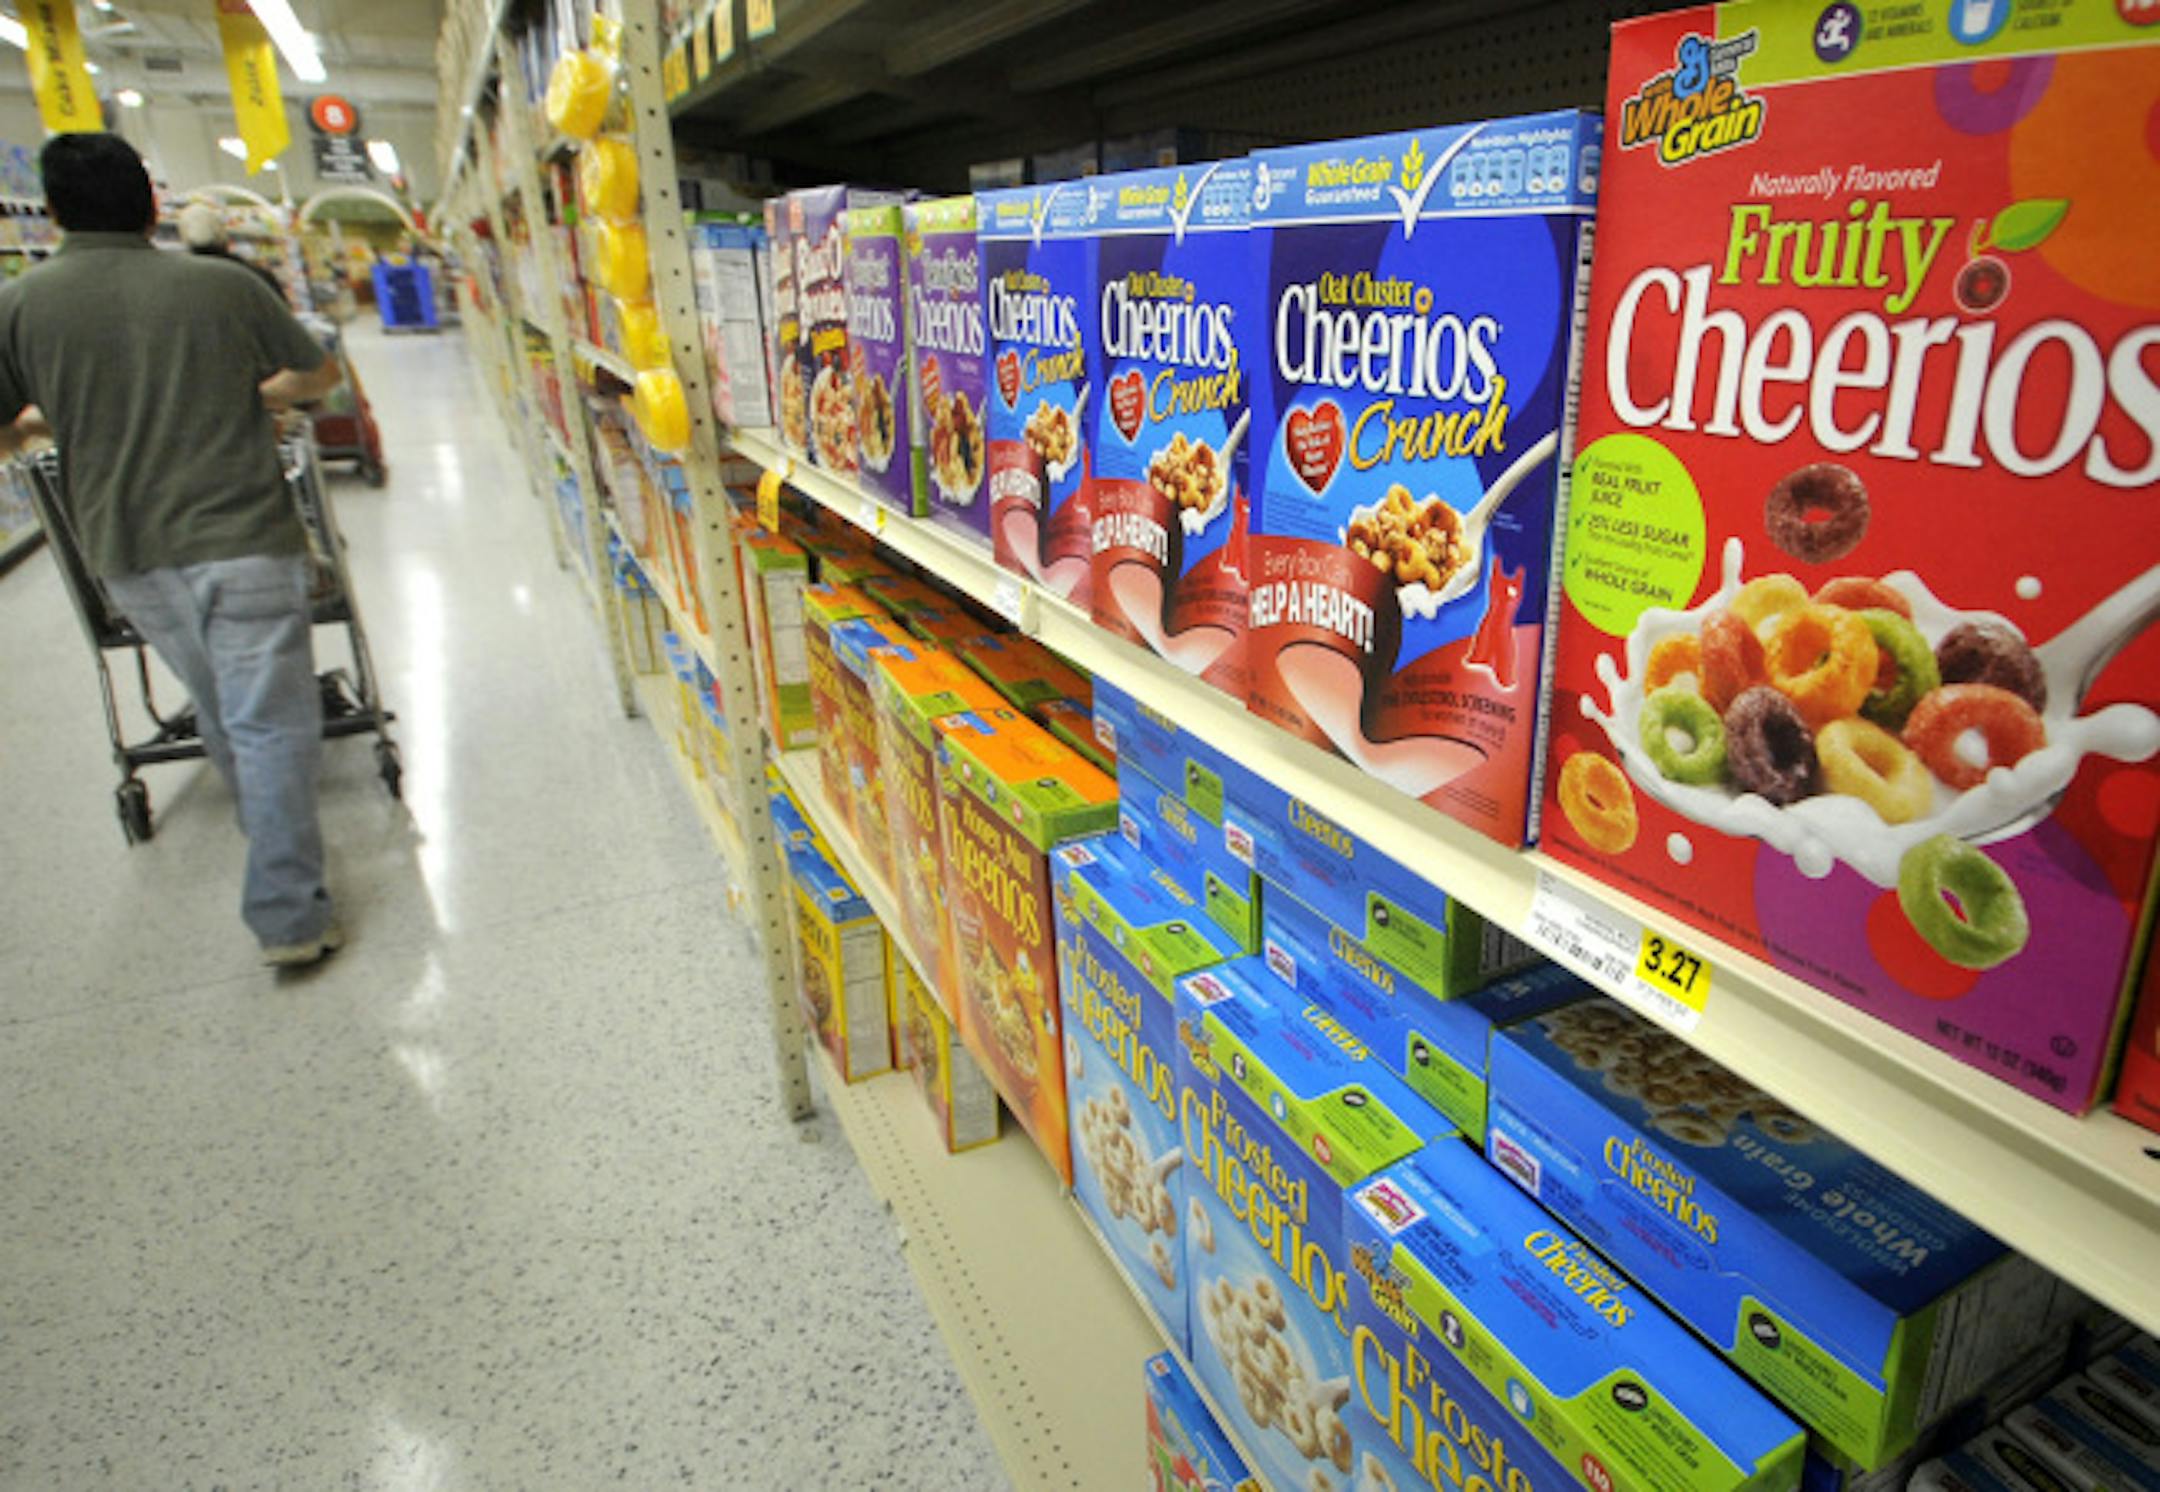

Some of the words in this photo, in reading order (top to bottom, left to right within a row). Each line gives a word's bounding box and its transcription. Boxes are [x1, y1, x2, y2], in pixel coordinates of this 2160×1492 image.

[1623, 76, 1735, 145] Whole
[1661, 97, 1761, 161] Grain
[1304, 184, 1381, 206] Guaranteed
[1307, 158, 1351, 189] Whole
[1351, 154, 1394, 185] Grain
[1749, 167, 1842, 201] Naturally
[1844, 159, 1942, 191] Flavored
[1319, 271, 1350, 305] Oat
[1350, 271, 1413, 307] Cluster
[1719, 199, 1954, 314] Fruity
[911, 284, 985, 358] Cheerios
[990, 277, 1078, 348] Cheerios
[1101, 279, 1233, 371] Cheerios
[1275, 282, 1499, 405] Cheerios
[1022, 330, 1085, 394] Crunch
[1148, 347, 1242, 424] Crunch
[1606, 264, 2160, 488] Cheerios
[1348, 374, 1511, 472] Crunch
[1642, 524, 1690, 549] SUGAR
[1248, 581, 1287, 632] HELP
[1287, 580, 1301, 624] A
[1301, 581, 1375, 654] HEART!
[943, 799, 1041, 949] Cheerios
[1644, 936, 1702, 994] 3.27
[1058, 938, 1177, 1123] Cheerios
[1210, 1087, 1309, 1226] Frosted
[1603, 1135, 1719, 1245] Cheerios
[1629, 1134, 1697, 1193] Frosted
[1733, 1134, 1816, 1192] Grain
[1181, 1085, 1349, 1338] Cheerios
[1820, 1187, 1929, 1268] Whole
[1523, 1229, 1635, 1329] Cheerios
[1352, 1323, 1493, 1492] Che
